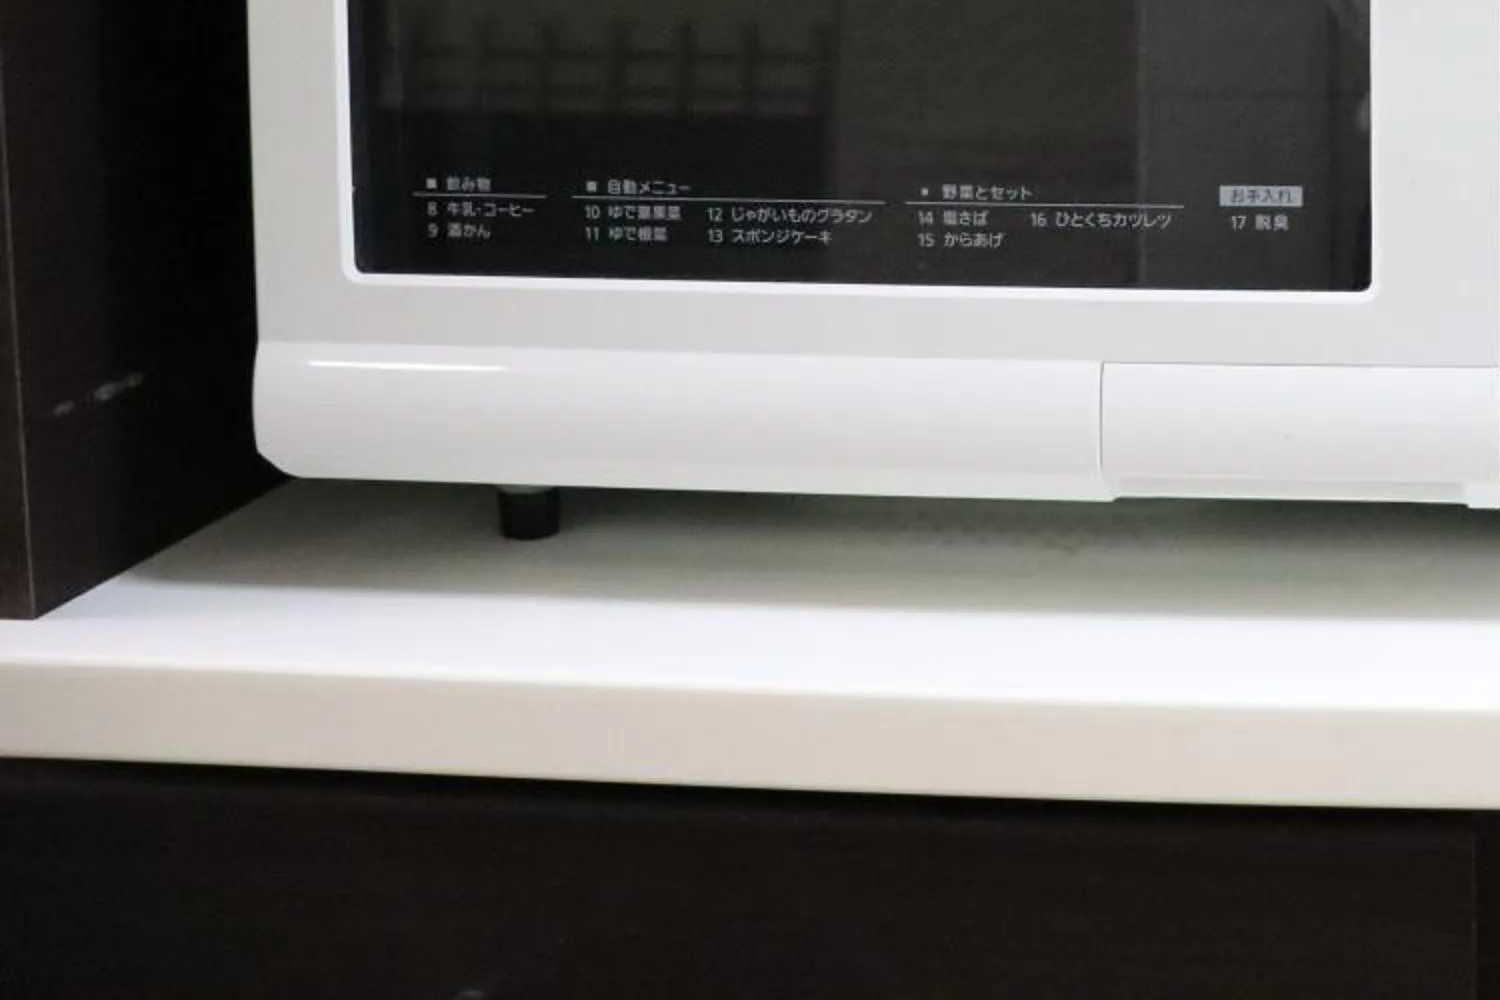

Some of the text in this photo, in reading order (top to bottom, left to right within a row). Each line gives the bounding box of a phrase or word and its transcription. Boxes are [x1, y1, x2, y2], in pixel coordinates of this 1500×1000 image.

[608, 179, 692, 195] 自動メニュー
[942, 184, 1033, 200] 野菜とセット
[585, 205, 601, 219] 10
[707, 207, 873, 223] 12 じゃがいものグラタン
[918, 211, 934, 224] 14
[1031, 212, 1171, 228] 16 ひとくちカツレツ
[1231, 214, 1289, 231] 17 脱臭
[585, 227, 600, 241] 11
[708, 229, 833, 244] 13 スポンジケーキ
[918, 231, 1004, 248] 15 からあげ
